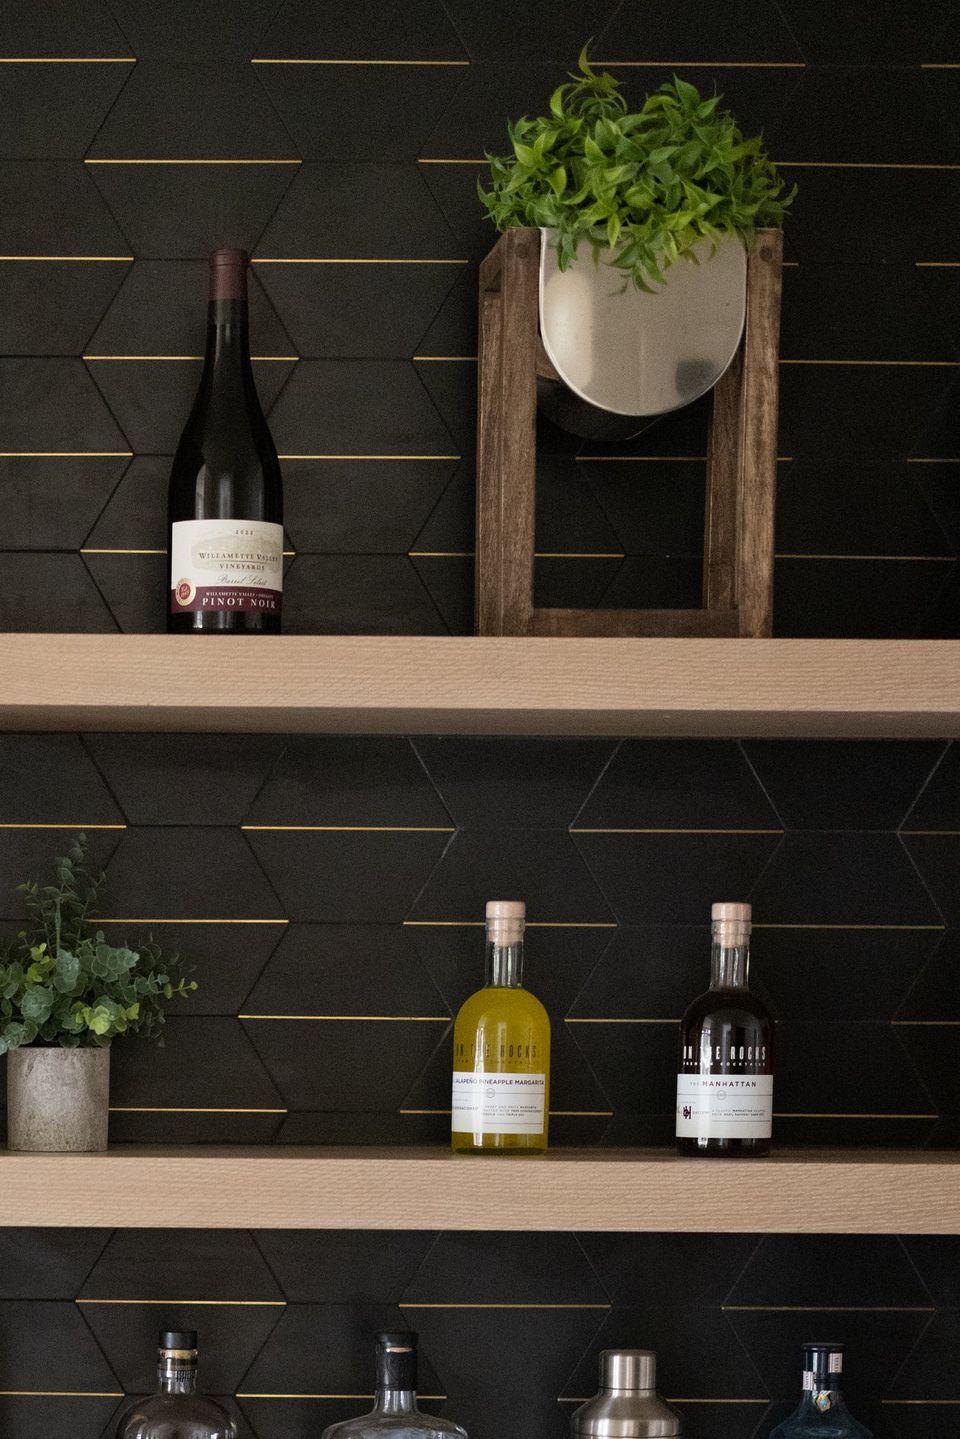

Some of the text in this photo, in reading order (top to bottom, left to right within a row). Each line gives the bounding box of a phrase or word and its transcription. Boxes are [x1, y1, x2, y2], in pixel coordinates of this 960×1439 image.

[202, 598, 276, 608] PINOT NOIR
[500, 1045, 537, 1058] ROCKS
[730, 1046, 766, 1060] ROCKS
